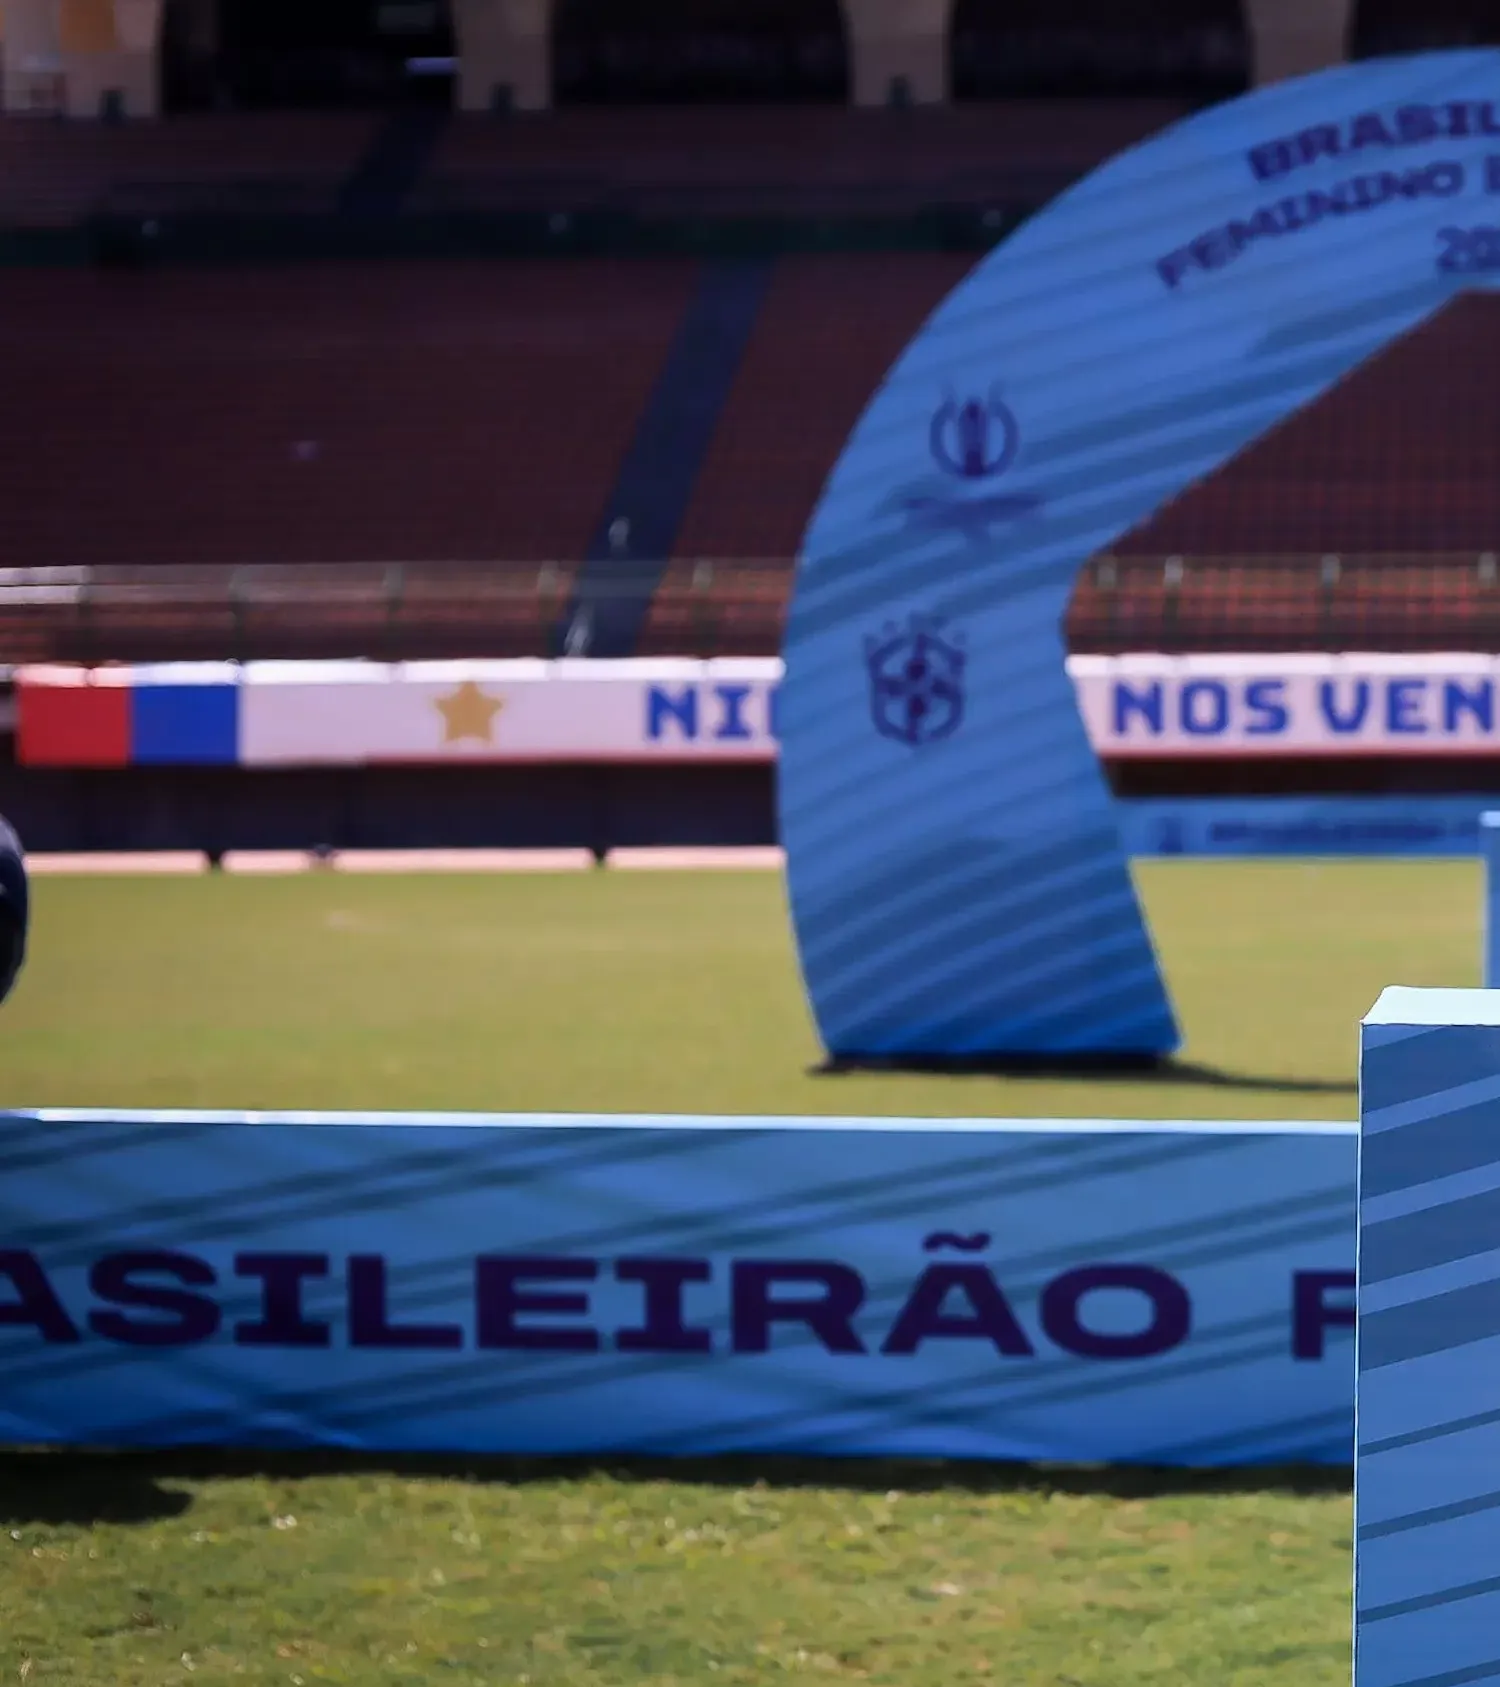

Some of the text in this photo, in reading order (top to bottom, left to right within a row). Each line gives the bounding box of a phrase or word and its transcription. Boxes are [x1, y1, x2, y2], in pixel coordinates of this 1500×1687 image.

[1156, 160, 1463, 288] FEMININO
[646, 684, 785, 739] NI
[1113, 678, 1290, 736] NOS
